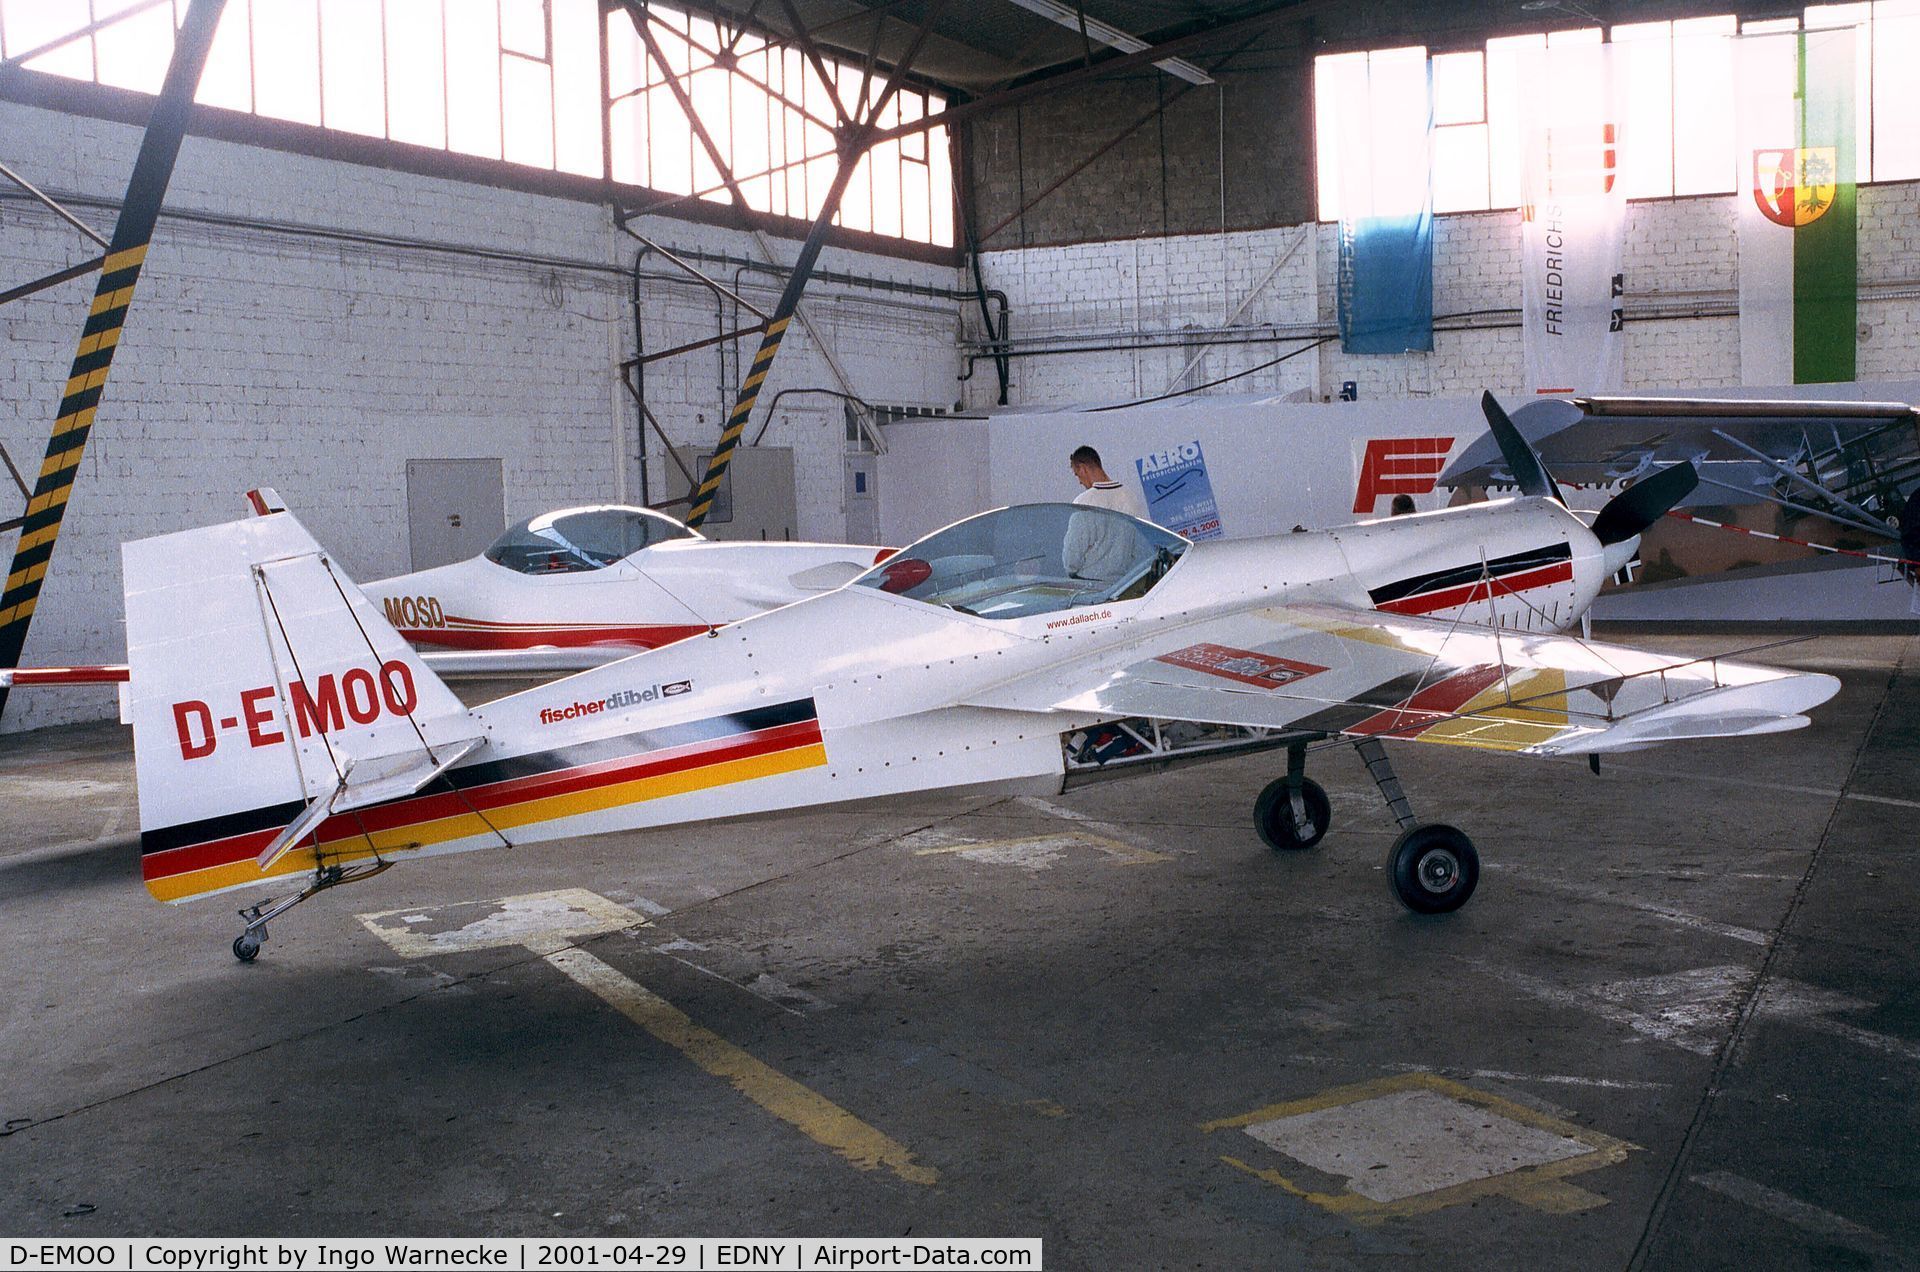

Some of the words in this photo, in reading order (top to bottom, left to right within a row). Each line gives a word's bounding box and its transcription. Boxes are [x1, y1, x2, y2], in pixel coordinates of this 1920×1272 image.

[1141, 441, 1199, 475] AERO
[1200, 519, 1220, 532] 2001
[384, 596, 446, 628] MOSD
[1046, 610, 1112, 629] www.dallach.de
[172, 659, 418, 761] D-EMOO
[540, 684, 660, 725] fischerdübel
